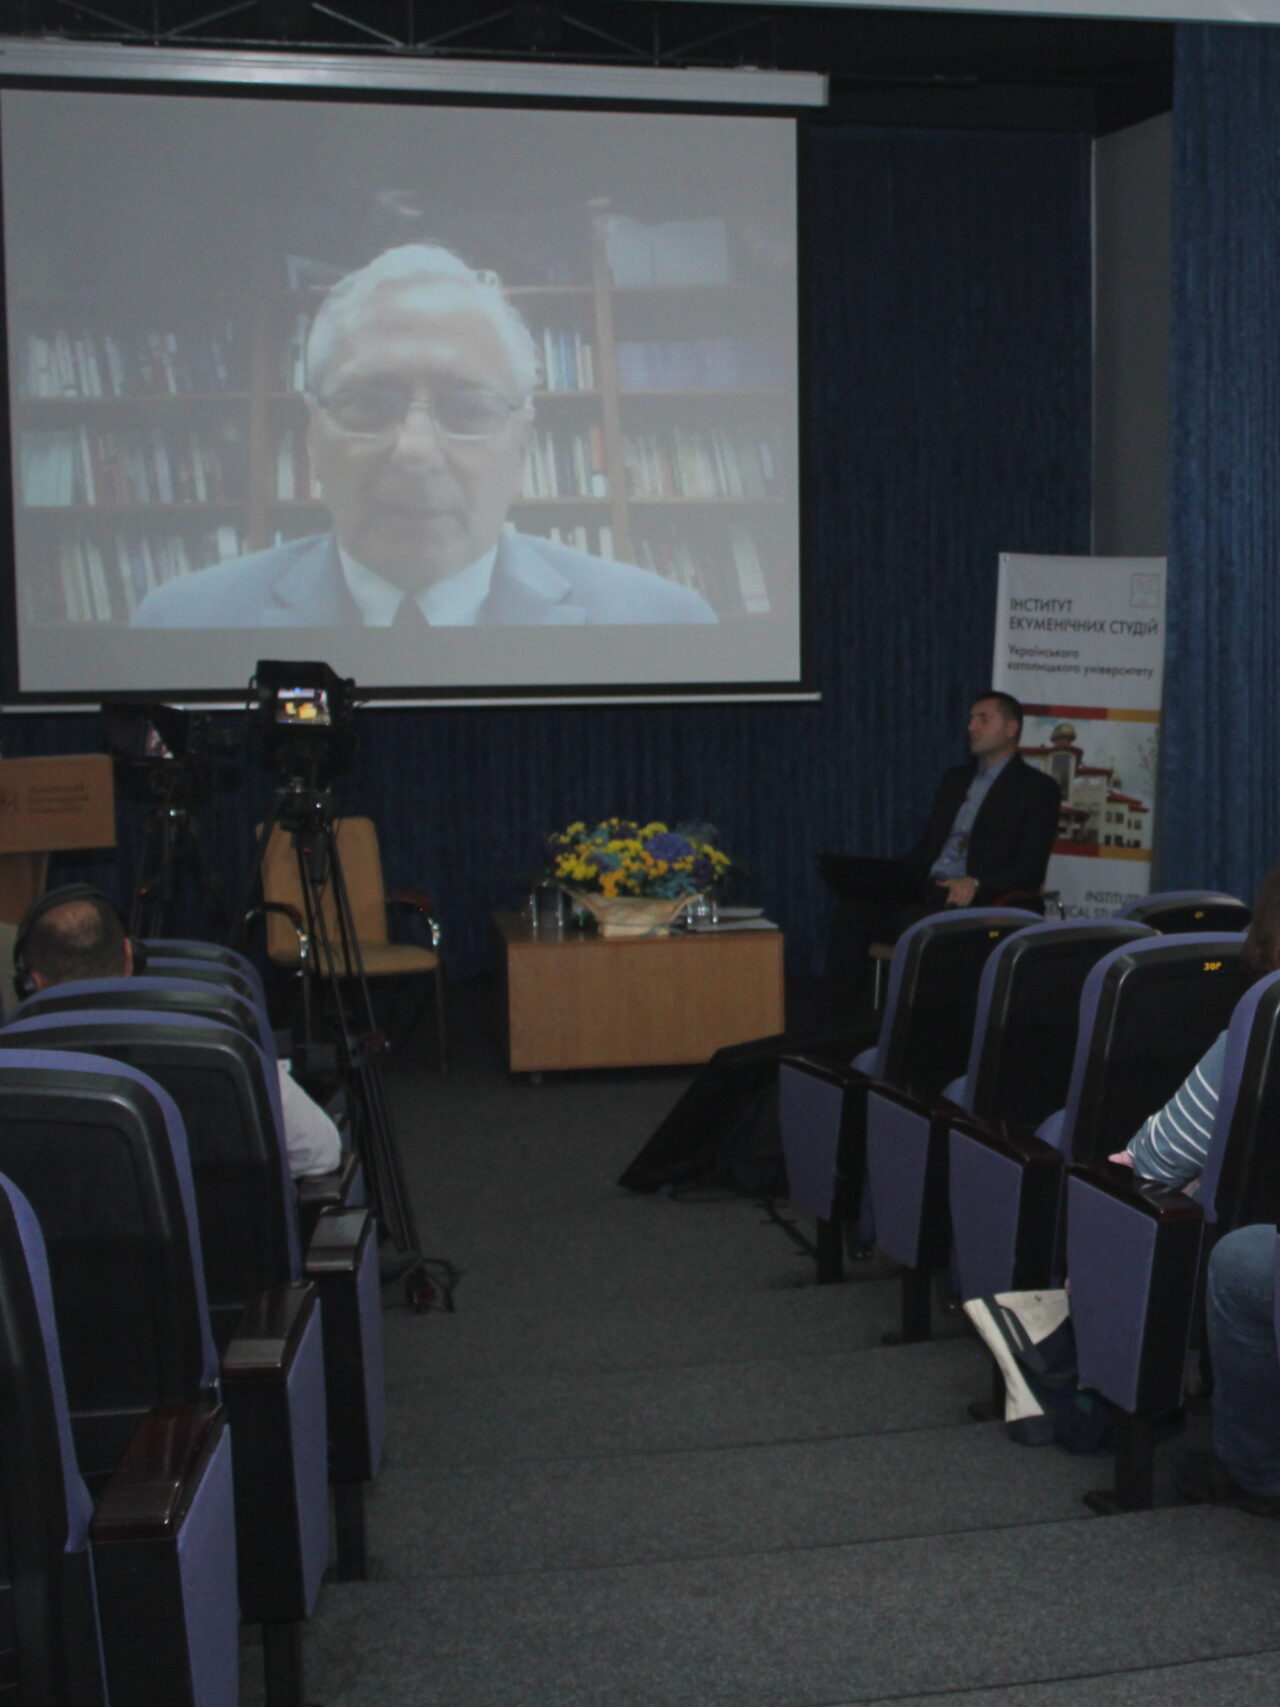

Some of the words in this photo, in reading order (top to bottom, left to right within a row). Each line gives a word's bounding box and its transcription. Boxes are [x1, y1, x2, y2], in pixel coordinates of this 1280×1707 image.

[1009, 598, 1073, 613] ІНСТИТУТ
[1009, 617, 1106, 633] ЕКУМЕНІЧНИХ
[1109, 619, 1159, 636] СТУДІЙ
